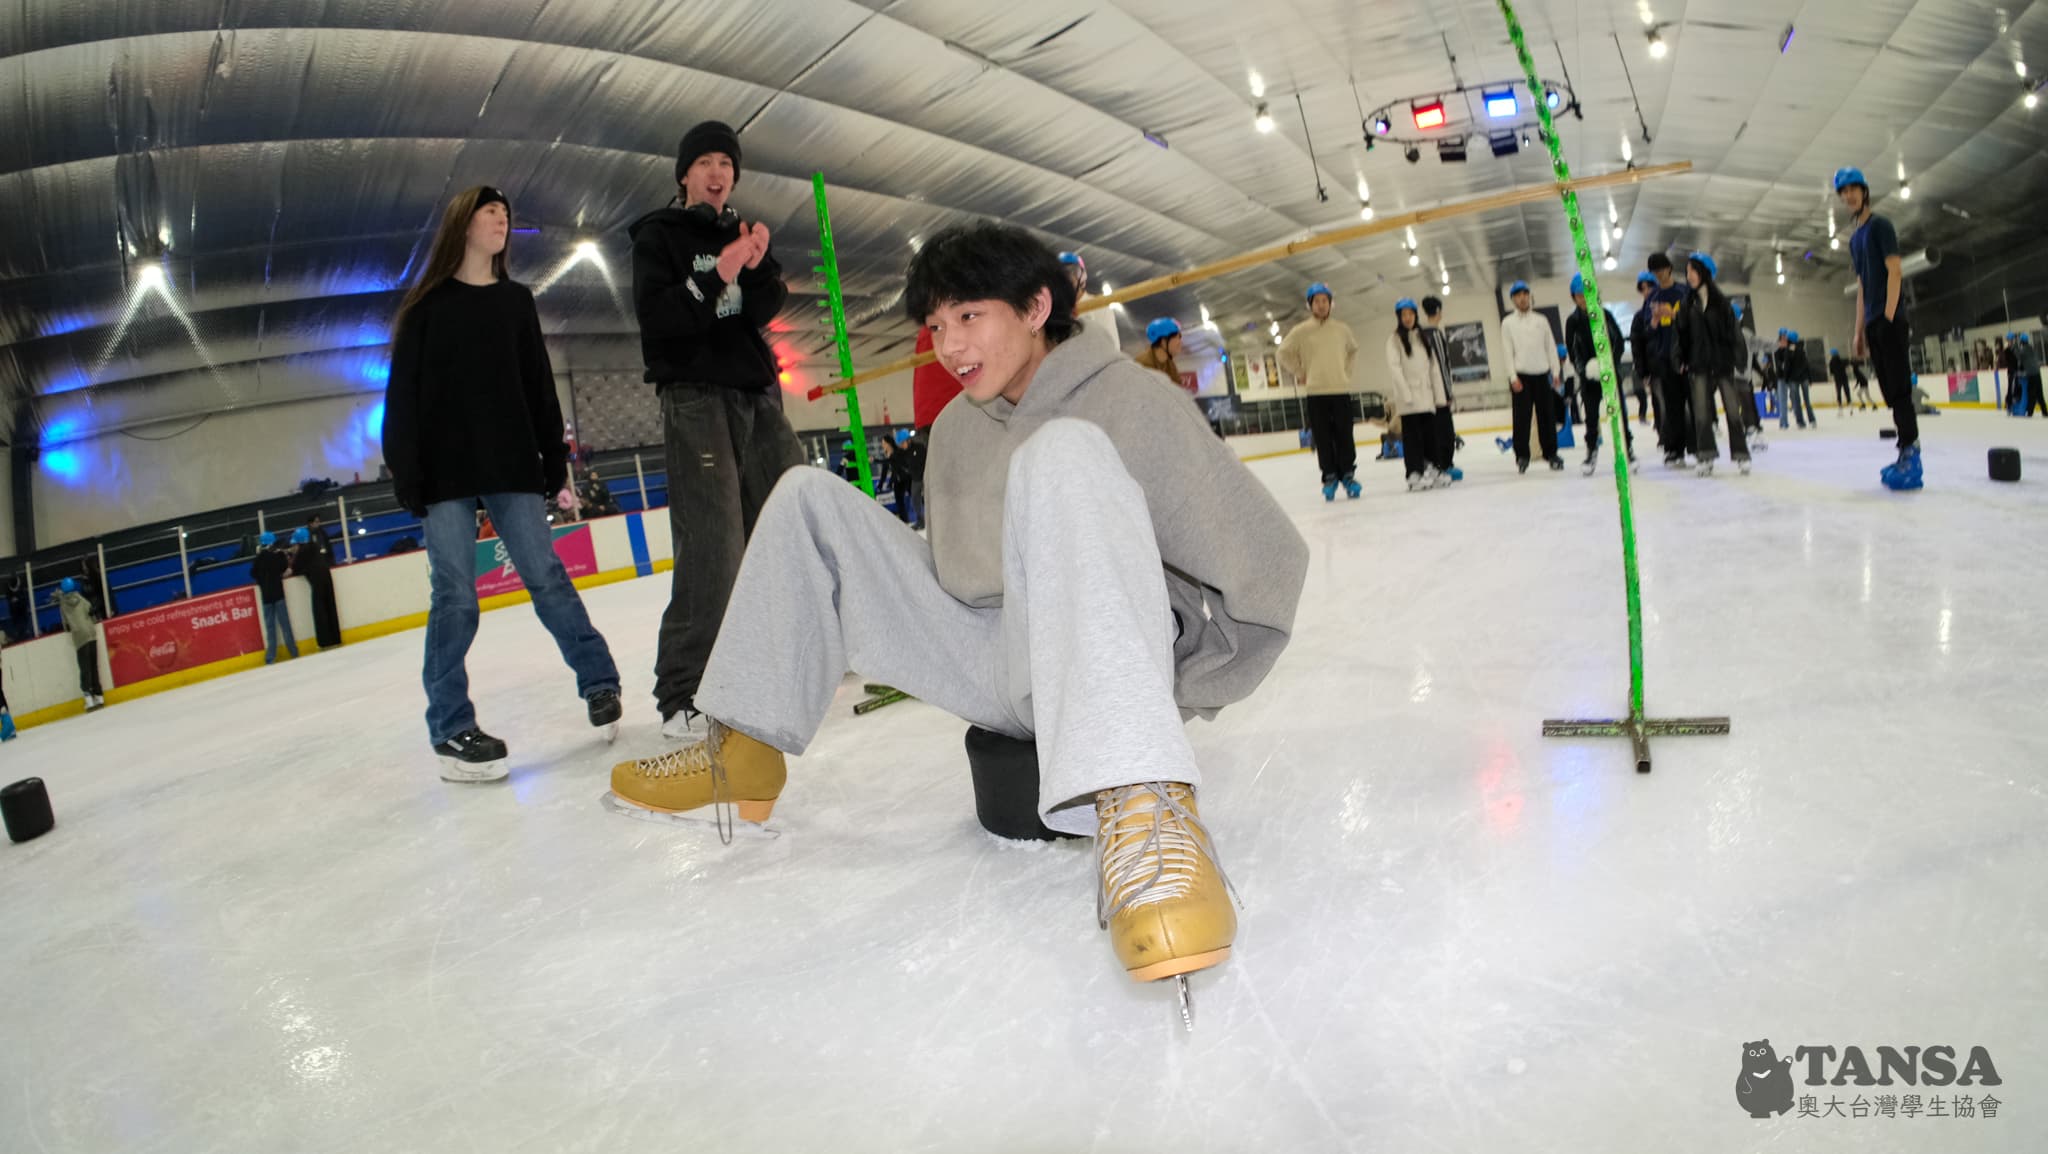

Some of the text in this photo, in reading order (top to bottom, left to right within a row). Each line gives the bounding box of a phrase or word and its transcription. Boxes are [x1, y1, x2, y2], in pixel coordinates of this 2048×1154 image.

[107, 594, 250, 635] enjoy ice cold refreshments at the
[191, 606, 253, 629] Snack Bar
